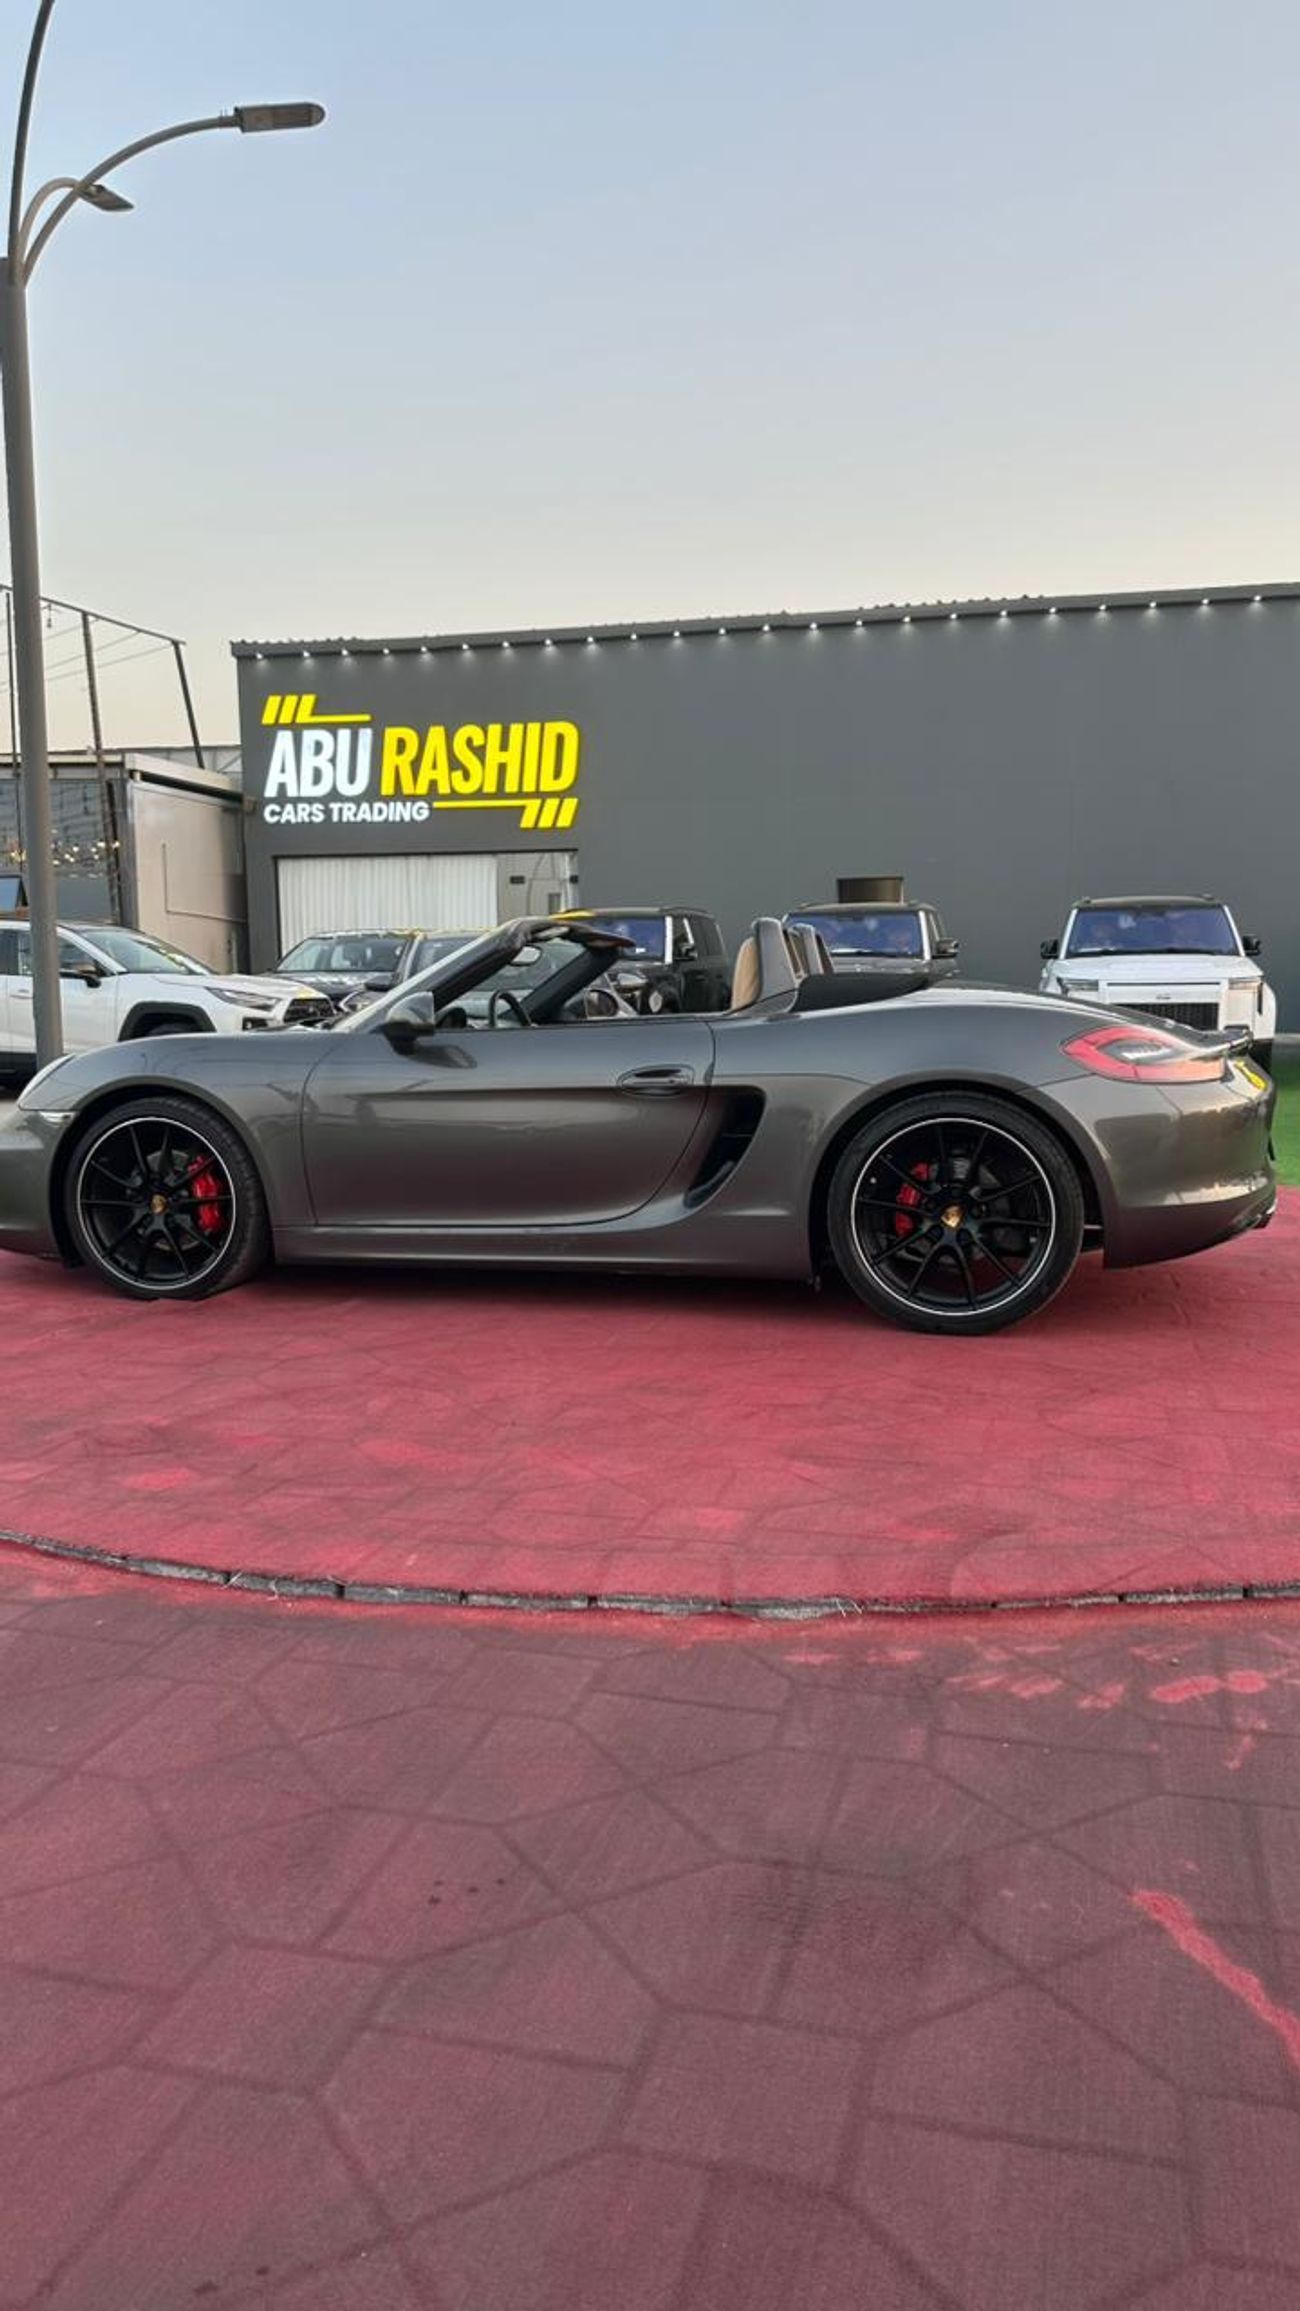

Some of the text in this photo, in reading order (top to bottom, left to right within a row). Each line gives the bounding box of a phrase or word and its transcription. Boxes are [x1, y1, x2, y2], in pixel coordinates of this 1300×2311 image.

[263, 721, 579, 798] ABU RASHID
[263, 801, 430, 824] CARS TRADING
